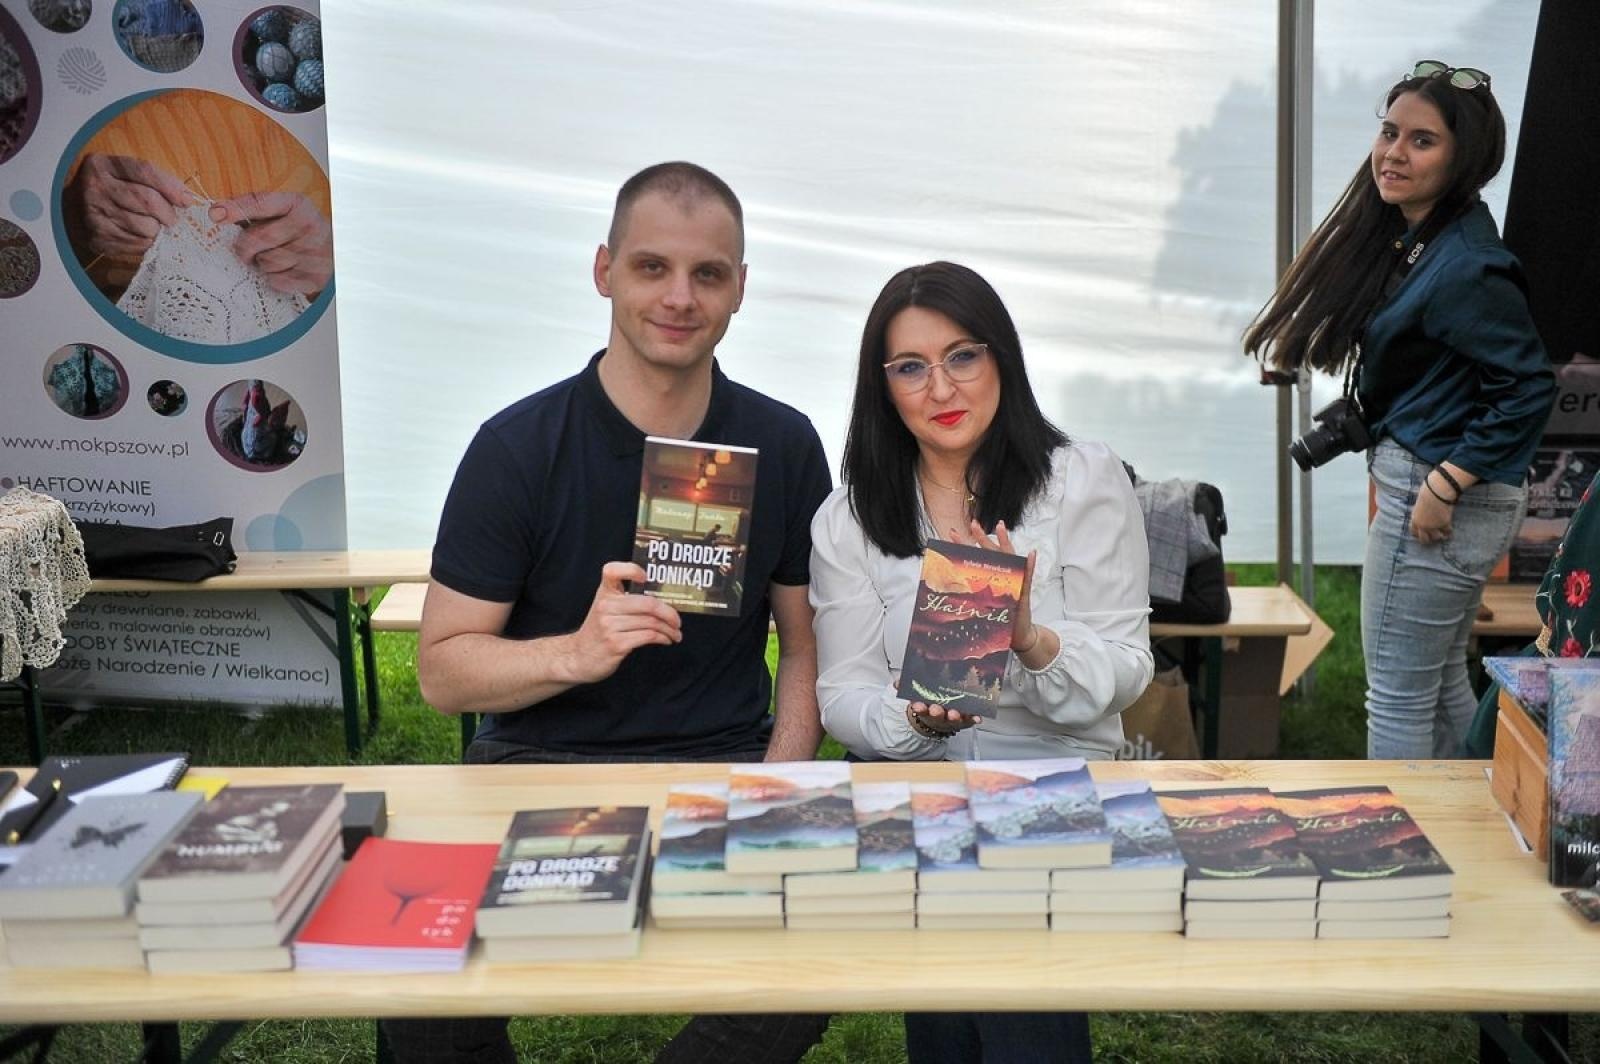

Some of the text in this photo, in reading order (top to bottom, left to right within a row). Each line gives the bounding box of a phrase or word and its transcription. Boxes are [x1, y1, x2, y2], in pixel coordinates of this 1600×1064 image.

[1407, 242, 1425, 265] EOS
[1, 436, 189, 459] www.mokpszow.pl
[18, 475, 152, 496] HAFTOWANIE
[648, 540, 733, 566] PO DRODZE
[647, 563, 714, 591] DONIKĄD
[194, 607, 261, 621] zabawki,
[108, 621, 194, 635] malowanie
[200, 624, 271, 641] obrazów)
[124, 634, 241, 658] ŚWIĄTECZNE
[97, 657, 206, 677] Narodzenie
[226, 663, 329, 686] Wielkanoc)
[507, 856, 620, 876] PO DRODZE
